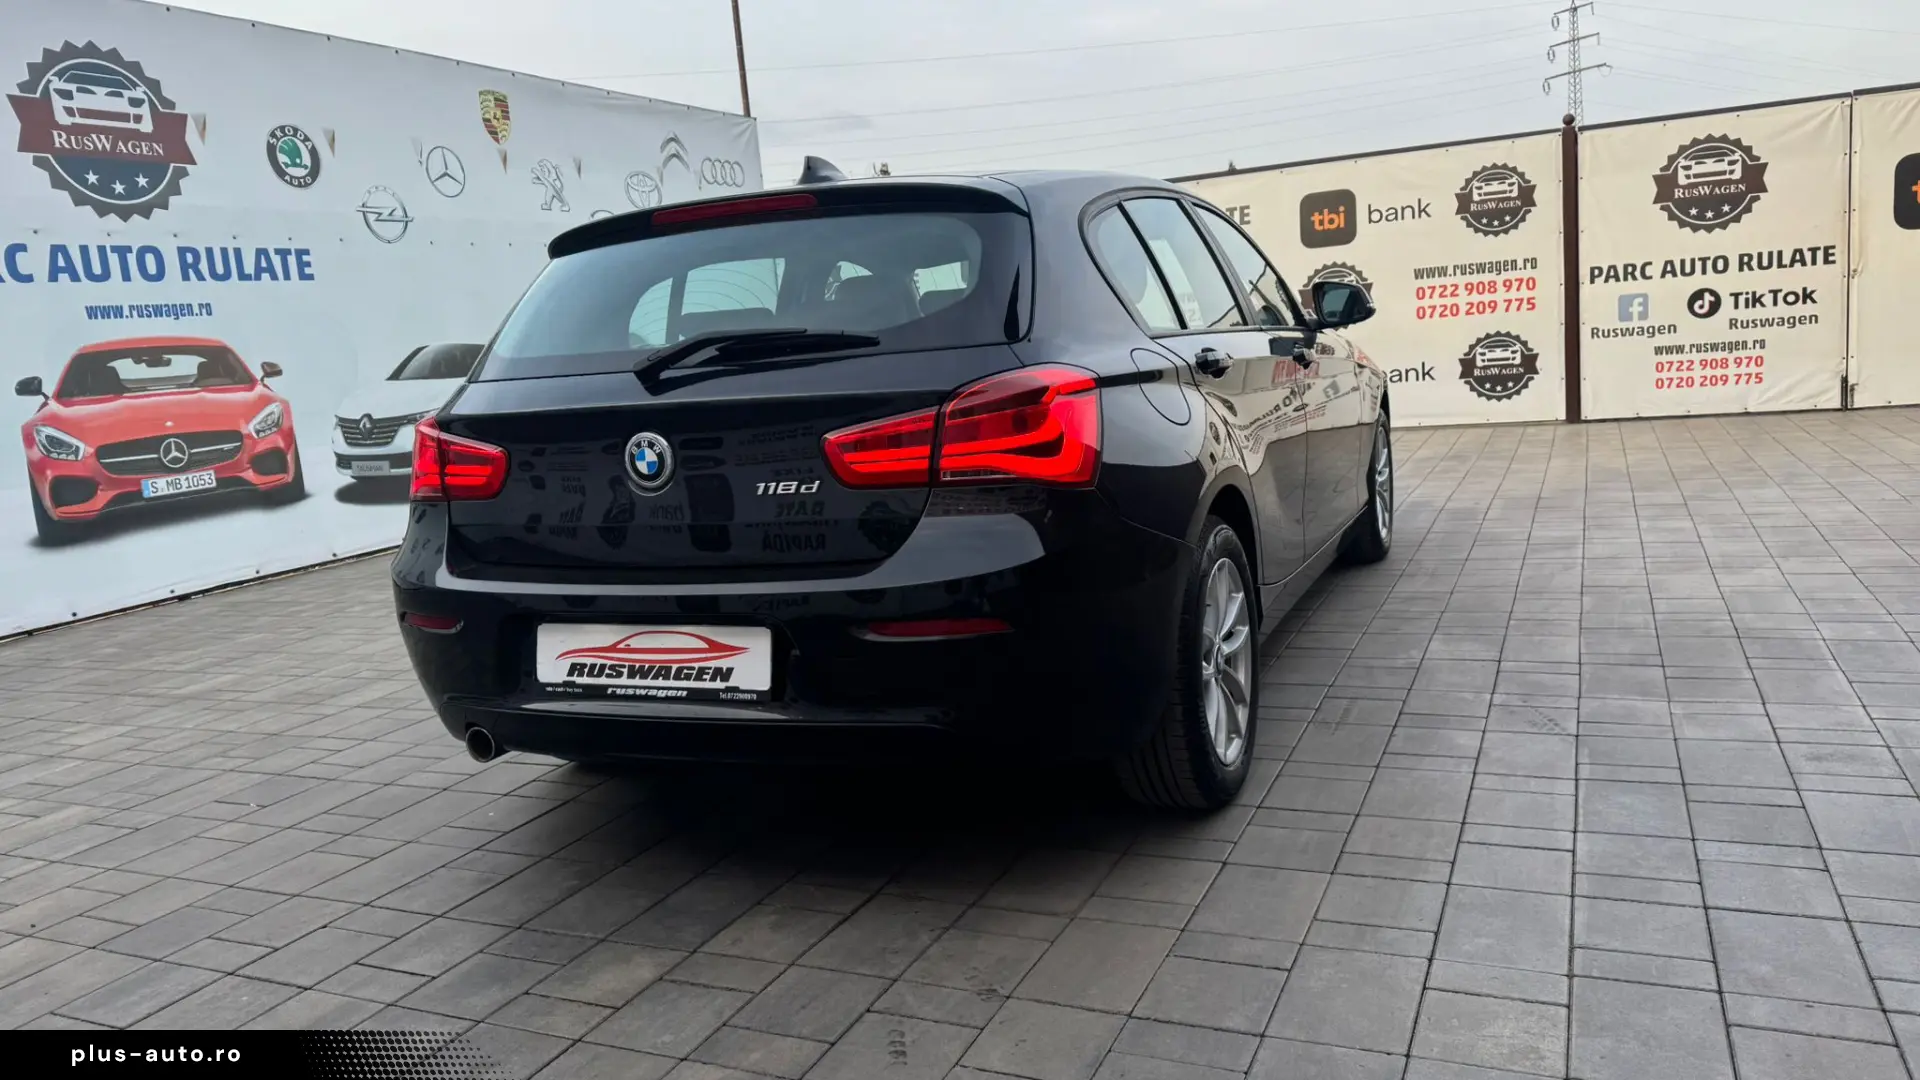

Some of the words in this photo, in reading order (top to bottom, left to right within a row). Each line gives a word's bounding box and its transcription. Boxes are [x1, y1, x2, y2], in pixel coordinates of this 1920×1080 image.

[284, 175, 312, 185] AUTO
[1311, 205, 1345, 231] tbi
[1367, 198, 1432, 224] bank
[0, 243, 34, 283] C
[47, 244, 166, 283] AUTO
[176, 246, 315, 281] RULATE
[1413, 257, 1538, 280] www.ruswagen.ro
[1589, 261, 1653, 285] PARC
[1660, 254, 1730, 279] AUTO
[1737, 245, 1837, 273] RULATE
[1416, 283, 1460, 300] 0722
[1464, 280, 1498, 296] 908
[1502, 276, 1537, 293] 970
[85, 302, 213, 321] www.ruswagen.ro
[1416, 302, 1460, 320] 0720
[1464, 299, 1498, 316] 209
[1502, 296, 1537, 313] 775
[1591, 323, 1677, 339] Ruswagen
[1728, 313, 1819, 330] Ruswagen
[1653, 338, 1766, 356] www.ruswagen.ro
[1655, 360, 1695, 374] 0722
[1699, 357, 1729, 371] 908
[1733, 355, 1765, 369] 970
[1655, 376, 1695, 390] 0720
[1699, 374, 1729, 388] 209
[1733, 371, 1765, 386] 775
[631, 440, 662, 454] BMW
[184, 473, 214, 489] 1053
[566, 662, 735, 683] RUSWAGEN
[607, 687, 688, 698] ruswagen
